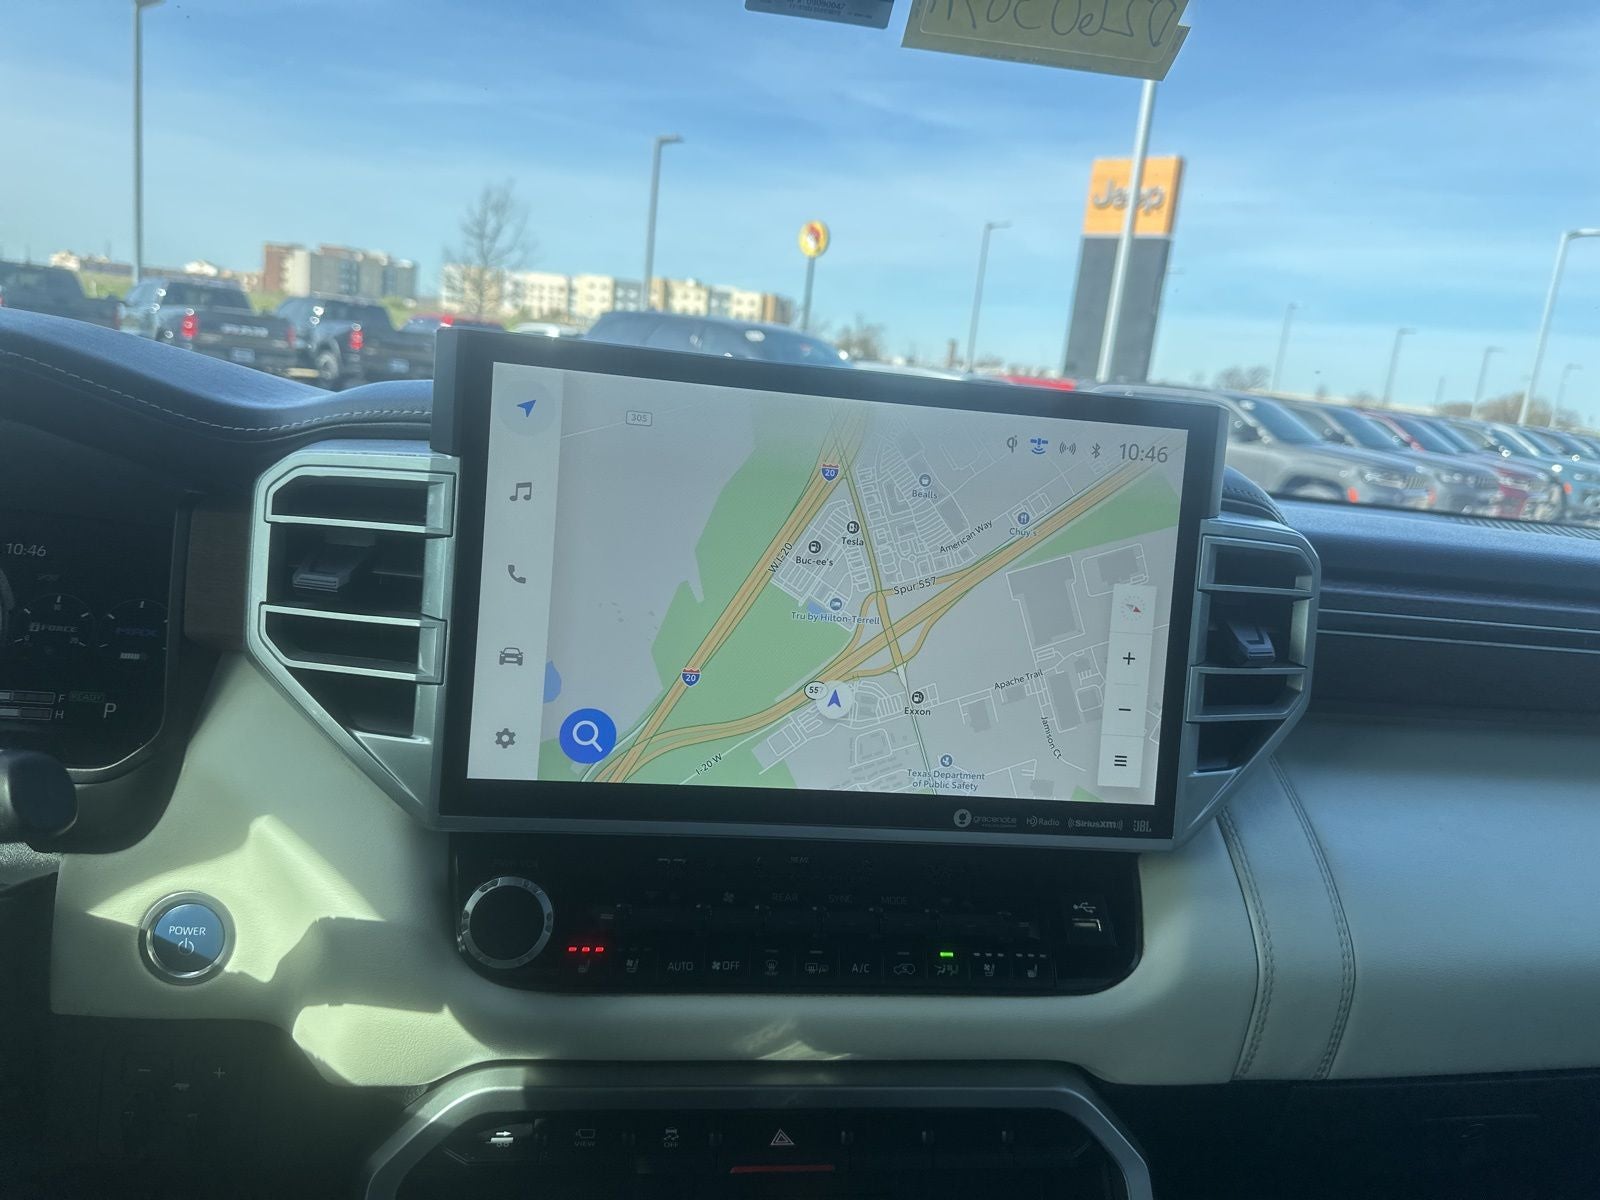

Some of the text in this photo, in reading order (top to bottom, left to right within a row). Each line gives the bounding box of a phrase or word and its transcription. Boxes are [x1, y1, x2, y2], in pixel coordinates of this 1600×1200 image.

[631, 413, 648, 423] 305
[1119, 443, 1169, 463] 10:46
[824, 468, 836, 477] 20
[912, 489, 938, 499] Bealls
[939, 520, 993, 553] American Way
[1009, 527, 1037, 537] Chuy's
[841, 536, 864, 546] Tesla
[5, 542, 47, 557] 10:46
[795, 555, 834, 566] Buc-ee's
[893, 576, 936, 595] Spur 557
[791, 611, 880, 625] Tru by Hilton-Terrell
[685, 674, 697, 682] 20
[994, 668, 1044, 690] Apache Trail
[55, 709, 65, 719] H
[103, 702, 117, 719] P
[904, 706, 931, 716] Exxon
[1041, 716, 1063, 760] Jamison Ct
[695, 753, 722, 776] I-20 W
[907, 768, 985, 781] Texas Department
[912, 780, 979, 792] of Public Safety
[972, 814, 1017, 824] gracenote
[1038, 817, 1060, 826] Radio
[1133, 819, 1152, 833] JBL
[168, 925, 206, 936] POWER
[666, 960, 695, 971] AUTO
[721, 961, 741, 971] OFF
[851, 962, 871, 974] A/C
